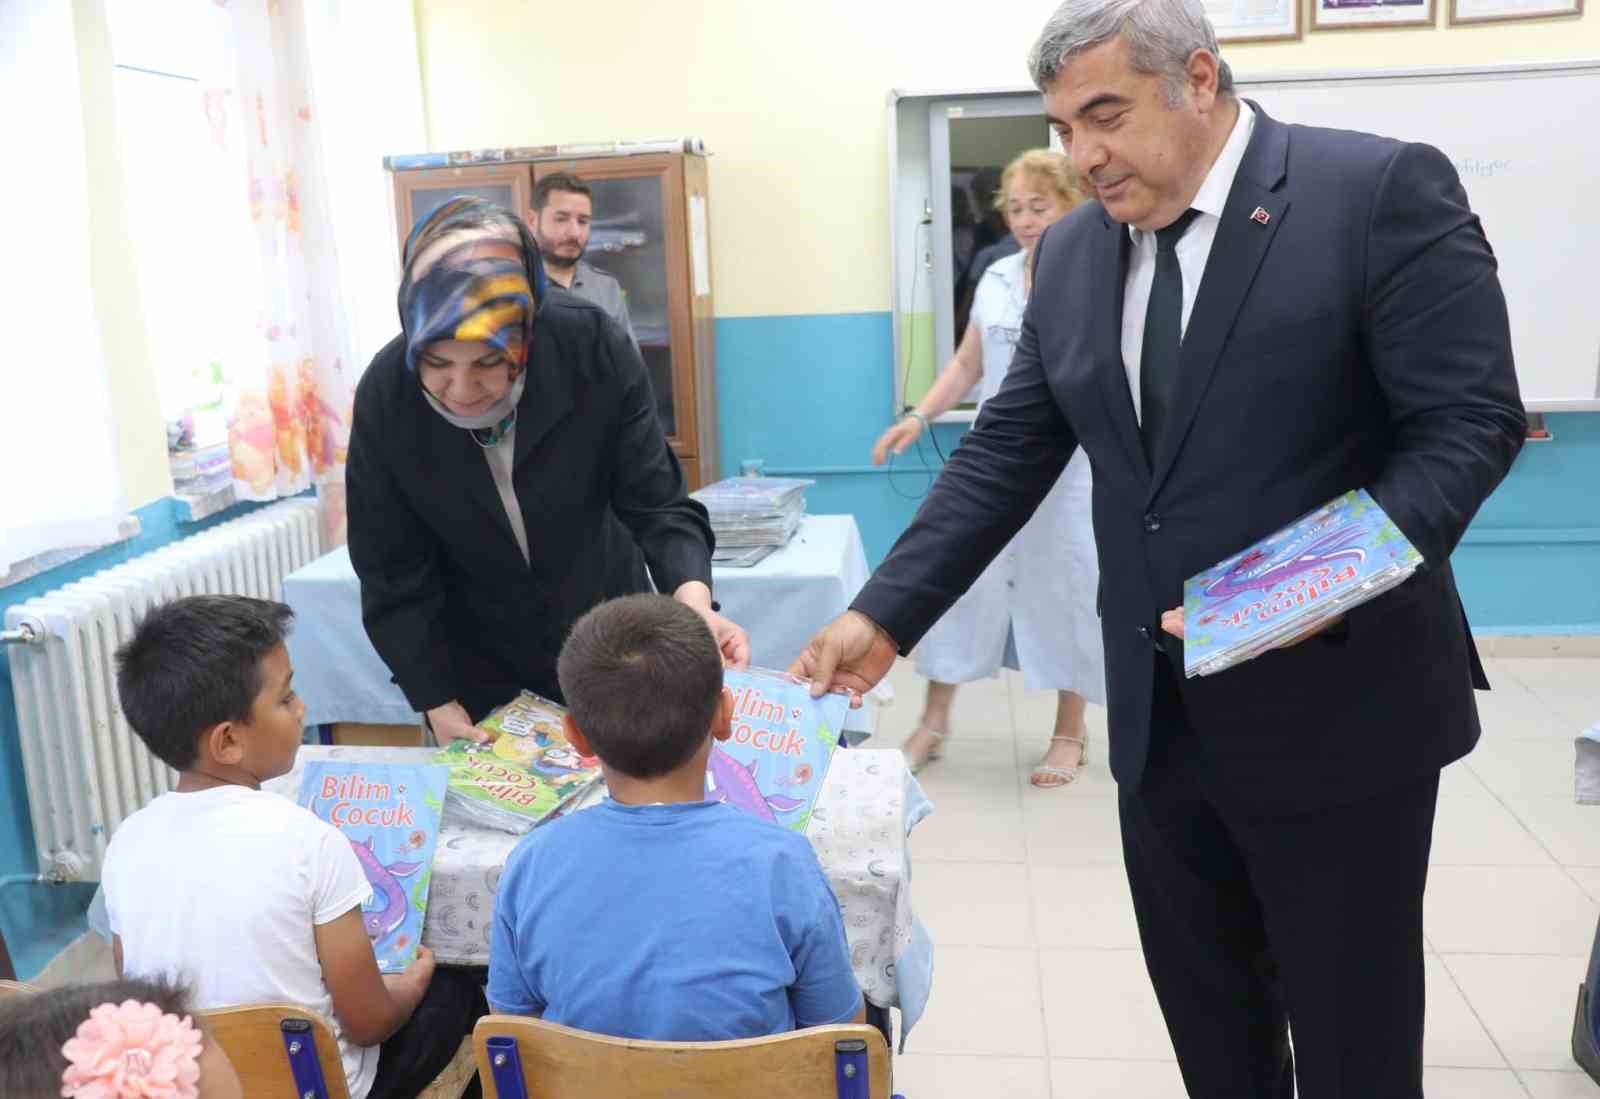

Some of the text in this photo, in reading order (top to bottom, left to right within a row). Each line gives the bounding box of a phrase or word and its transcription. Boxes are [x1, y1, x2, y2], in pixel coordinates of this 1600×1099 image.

[733, 687, 784, 722] ilim
[734, 723, 806, 756] ocuk
[320, 775, 391, 800] Bilim
[467, 755, 537, 790] Çocuk
[475, 776, 537, 806] Bilim
[329, 800, 415, 827] Çocuk
